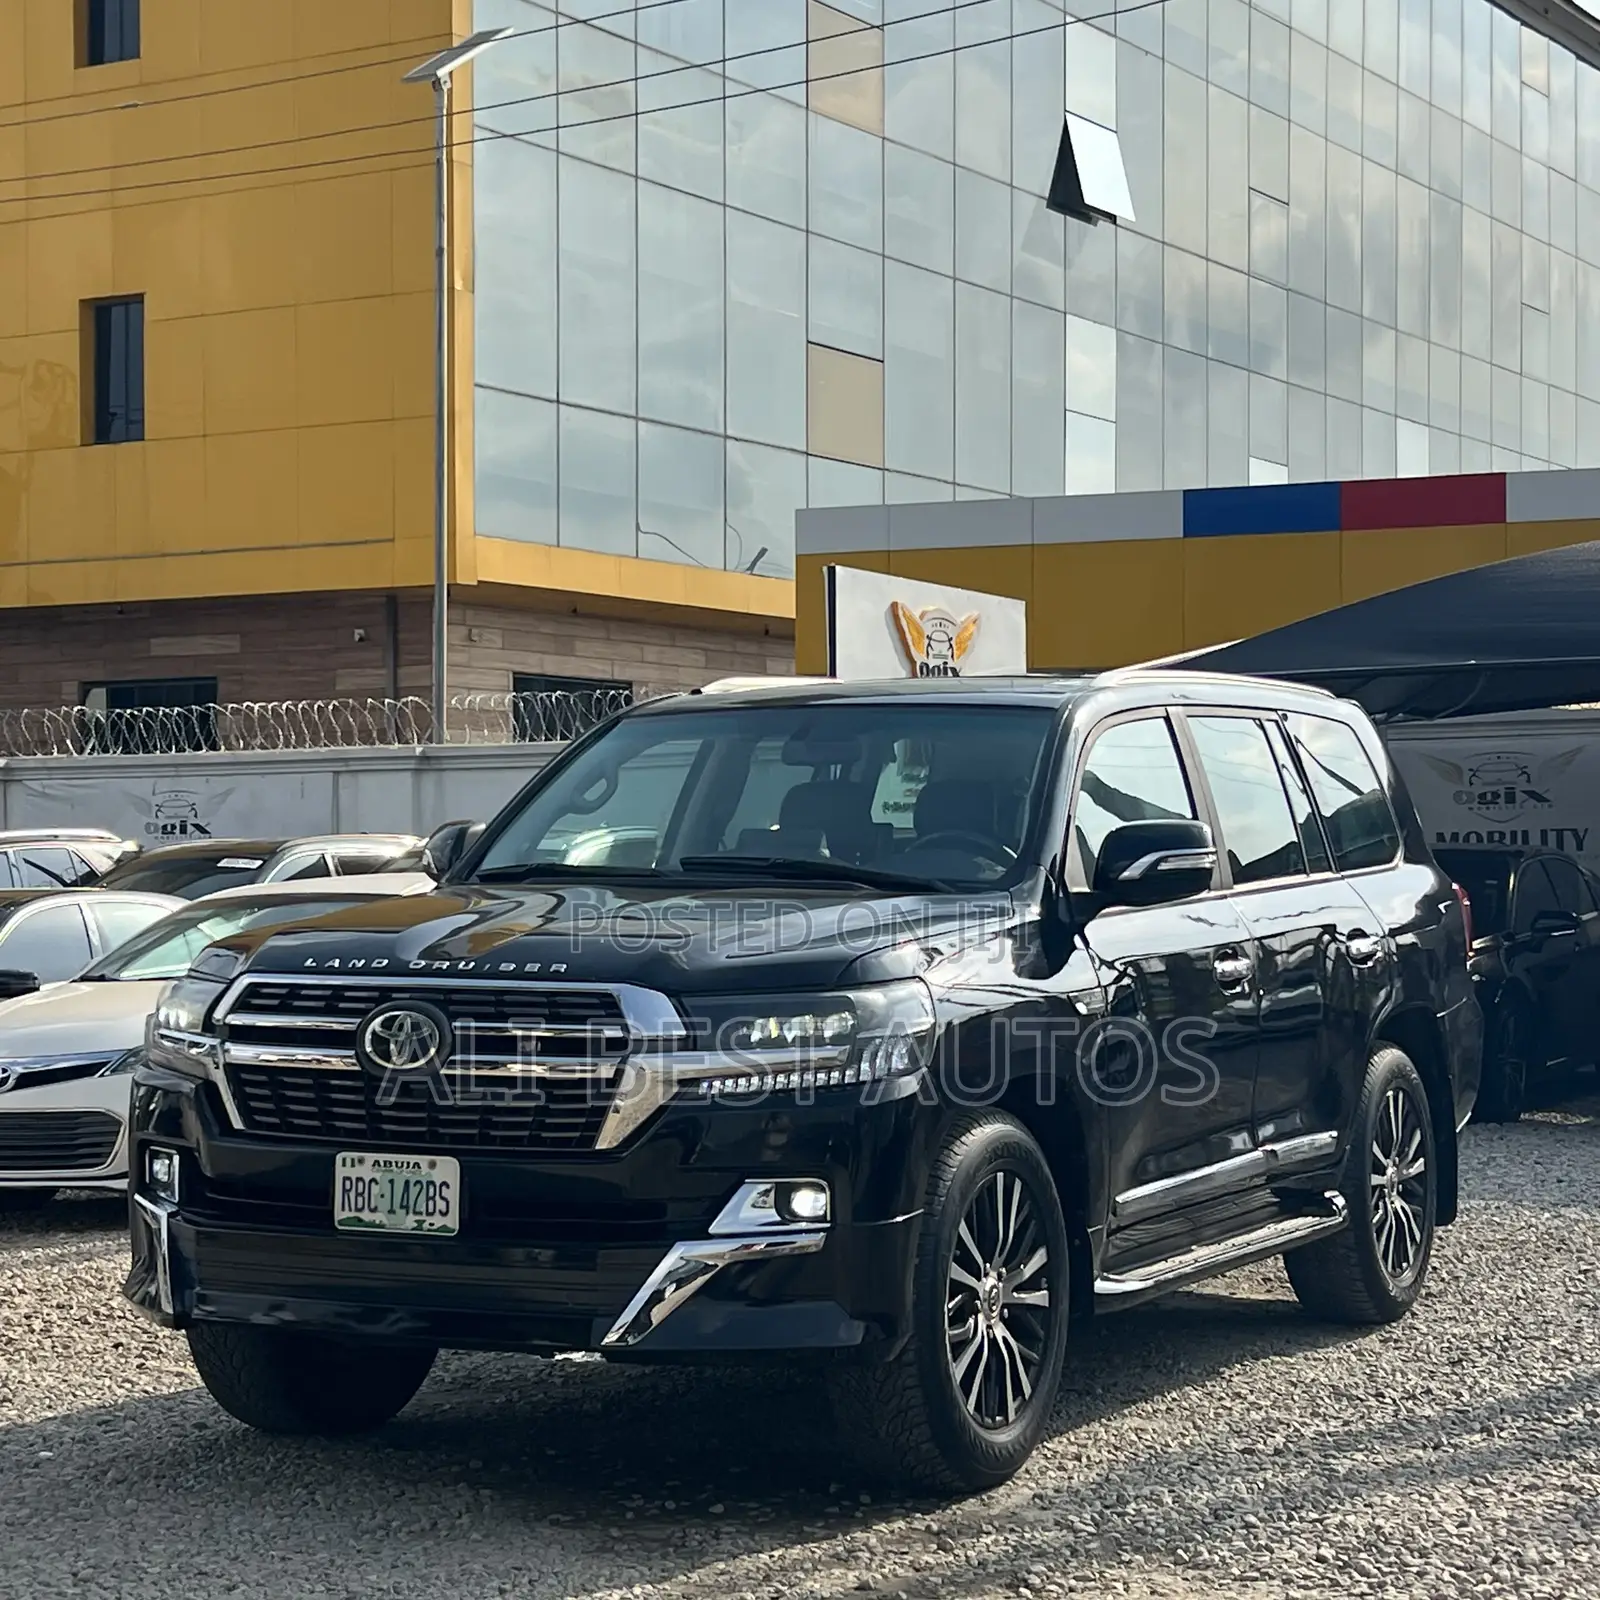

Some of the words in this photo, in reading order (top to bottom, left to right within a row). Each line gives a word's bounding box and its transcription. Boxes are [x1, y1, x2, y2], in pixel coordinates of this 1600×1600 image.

[1435, 827, 1589, 852] MOBILITY
[303, 957, 390, 970] LAND
[407, 959, 568, 973] CRUISER
[371, 1159, 423, 1170] ABUJA
